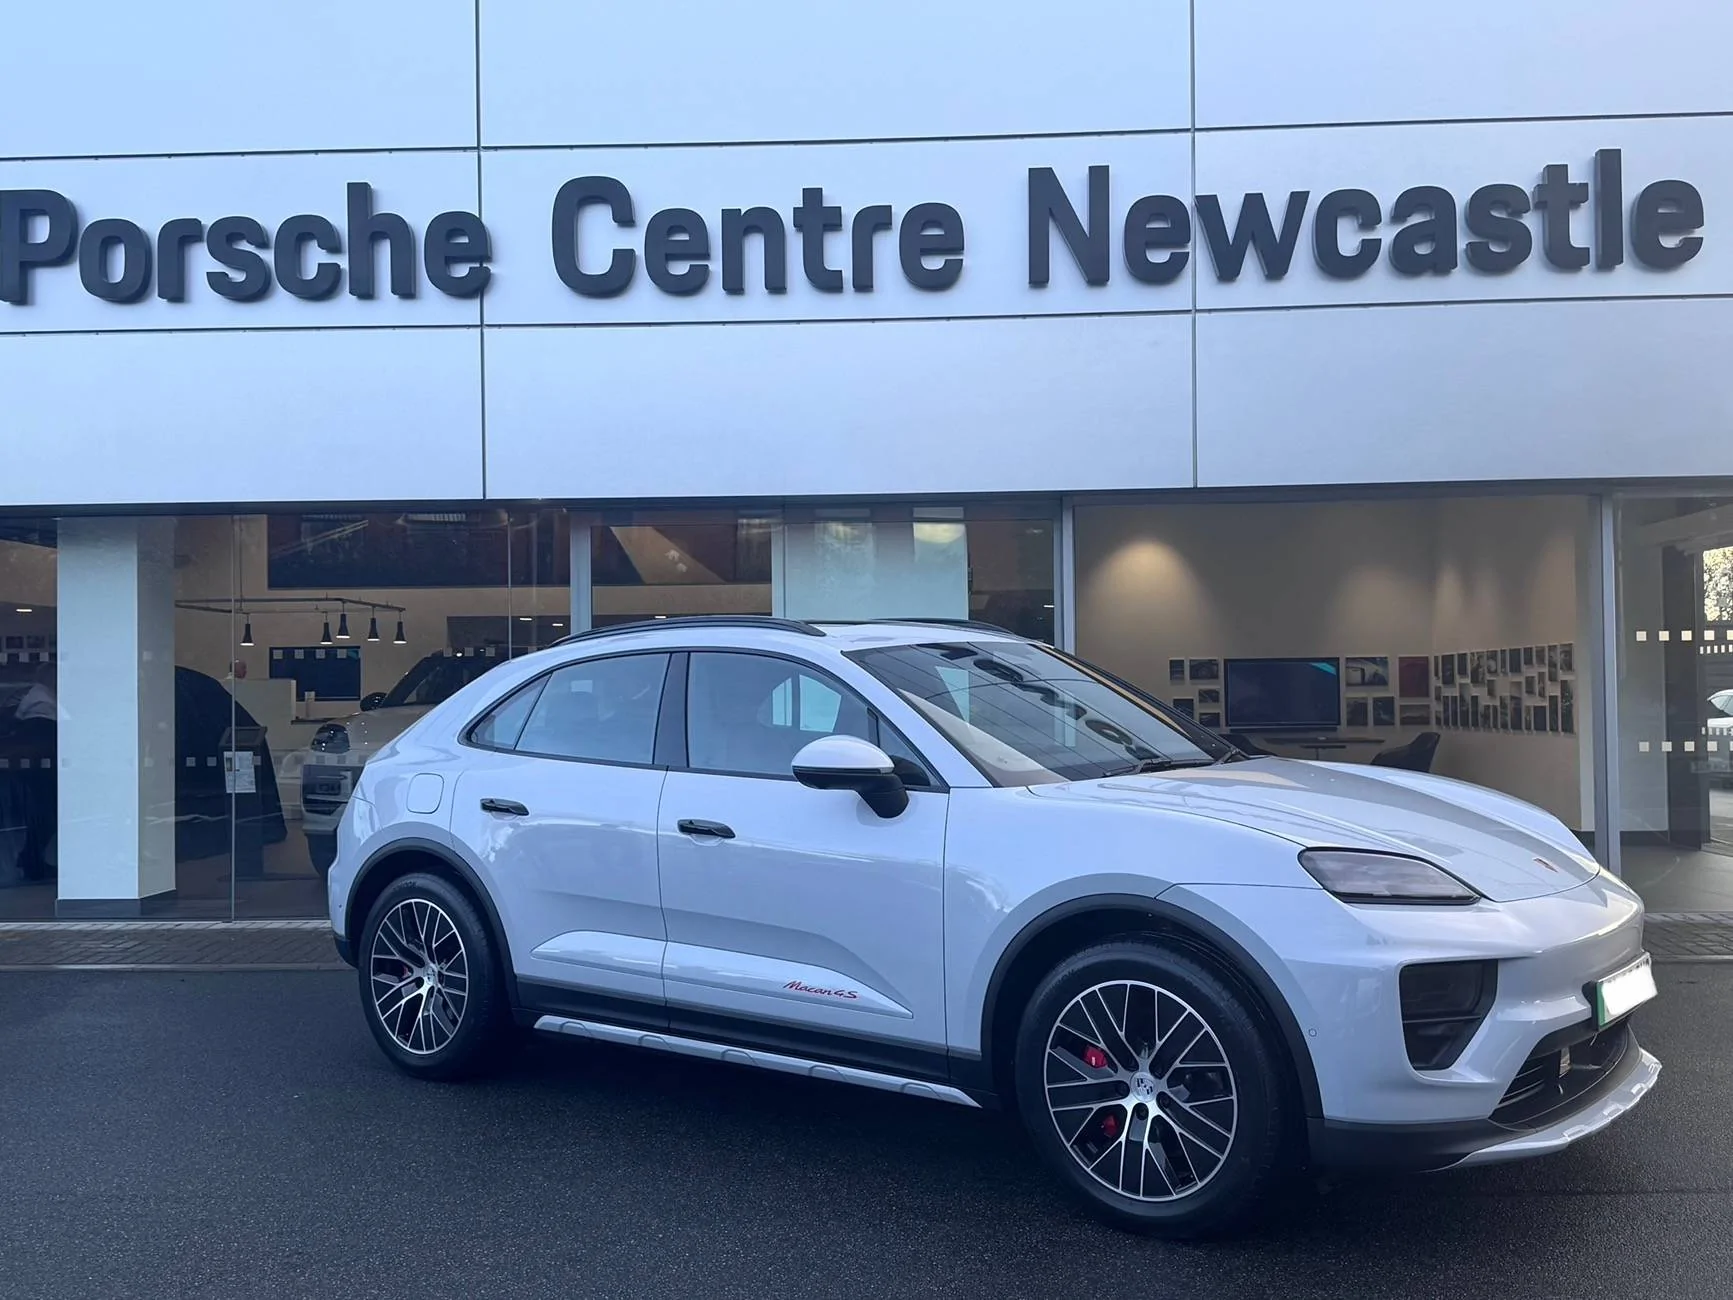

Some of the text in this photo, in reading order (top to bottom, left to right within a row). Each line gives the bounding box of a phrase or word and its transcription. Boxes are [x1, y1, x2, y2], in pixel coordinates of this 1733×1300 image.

[0, 149, 1705, 305] Porsche Centre Newcastle
[782, 980, 832, 996] Macan
